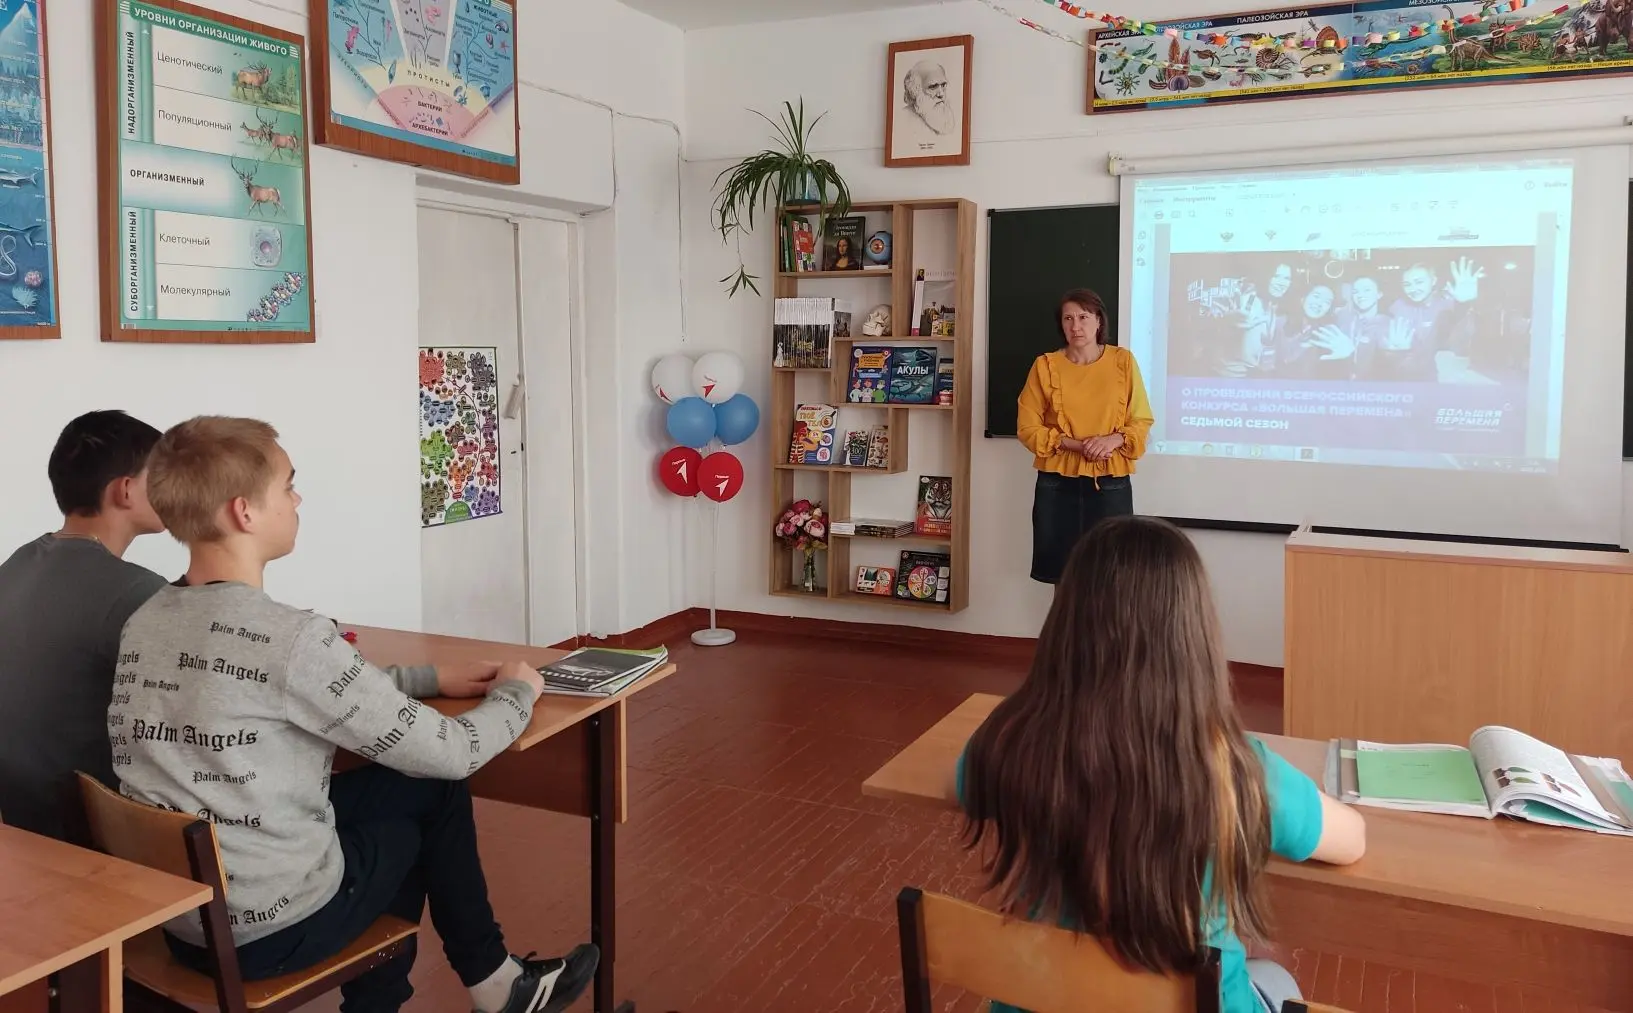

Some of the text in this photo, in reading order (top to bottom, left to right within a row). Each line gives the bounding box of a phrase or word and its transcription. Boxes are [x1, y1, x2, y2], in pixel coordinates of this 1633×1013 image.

[1237, 10, 1309, 23] ПАЛЕОЗОЙСКАЯ ЭРА
[134, 8, 287, 55] УРОВНИ ОРГАНИЗАЦИИ ЖИВОГО
[157, 52, 223, 75] Ценотический
[128, 31, 136, 134] НАДОРГАНИЗМЕННЫЙ
[407, 70, 450, 87] ПРОТИСТЫ
[418, 101, 443, 112] БАКТЕРИИ
[158, 110, 232, 132] Популяционный
[411, 123, 449, 136] АРХЕБАКТЕРИИ
[130, 168, 205, 187] ОРГАНИЗМЕННЫЙ
[159, 233, 211, 247] Клеточный
[160, 284, 231, 298] Молекулярный
[897, 366, 929, 376] АКУЛЫ
[1181, 400, 1249, 412] КОНКУРСА
[1283, 389, 1414, 404] ВСЕРОССИЙСКОГО
[1180, 415, 1289, 430] СЕДЬМОЙ СЕЗОН
[209, 621, 271, 644] Palm Angels
[177, 652, 269, 684] Palm Angels
[159, 680, 180, 691] Angels
[327, 664, 362, 698] Palm
[335, 704, 361, 724] Angels
[132, 718, 258, 752] Palm Angels
[436, 719, 449, 741] Palm
[354, 727, 404, 761] Palm
[192, 770, 257, 785] Palm Angels
[243, 896, 290, 924] Angels
